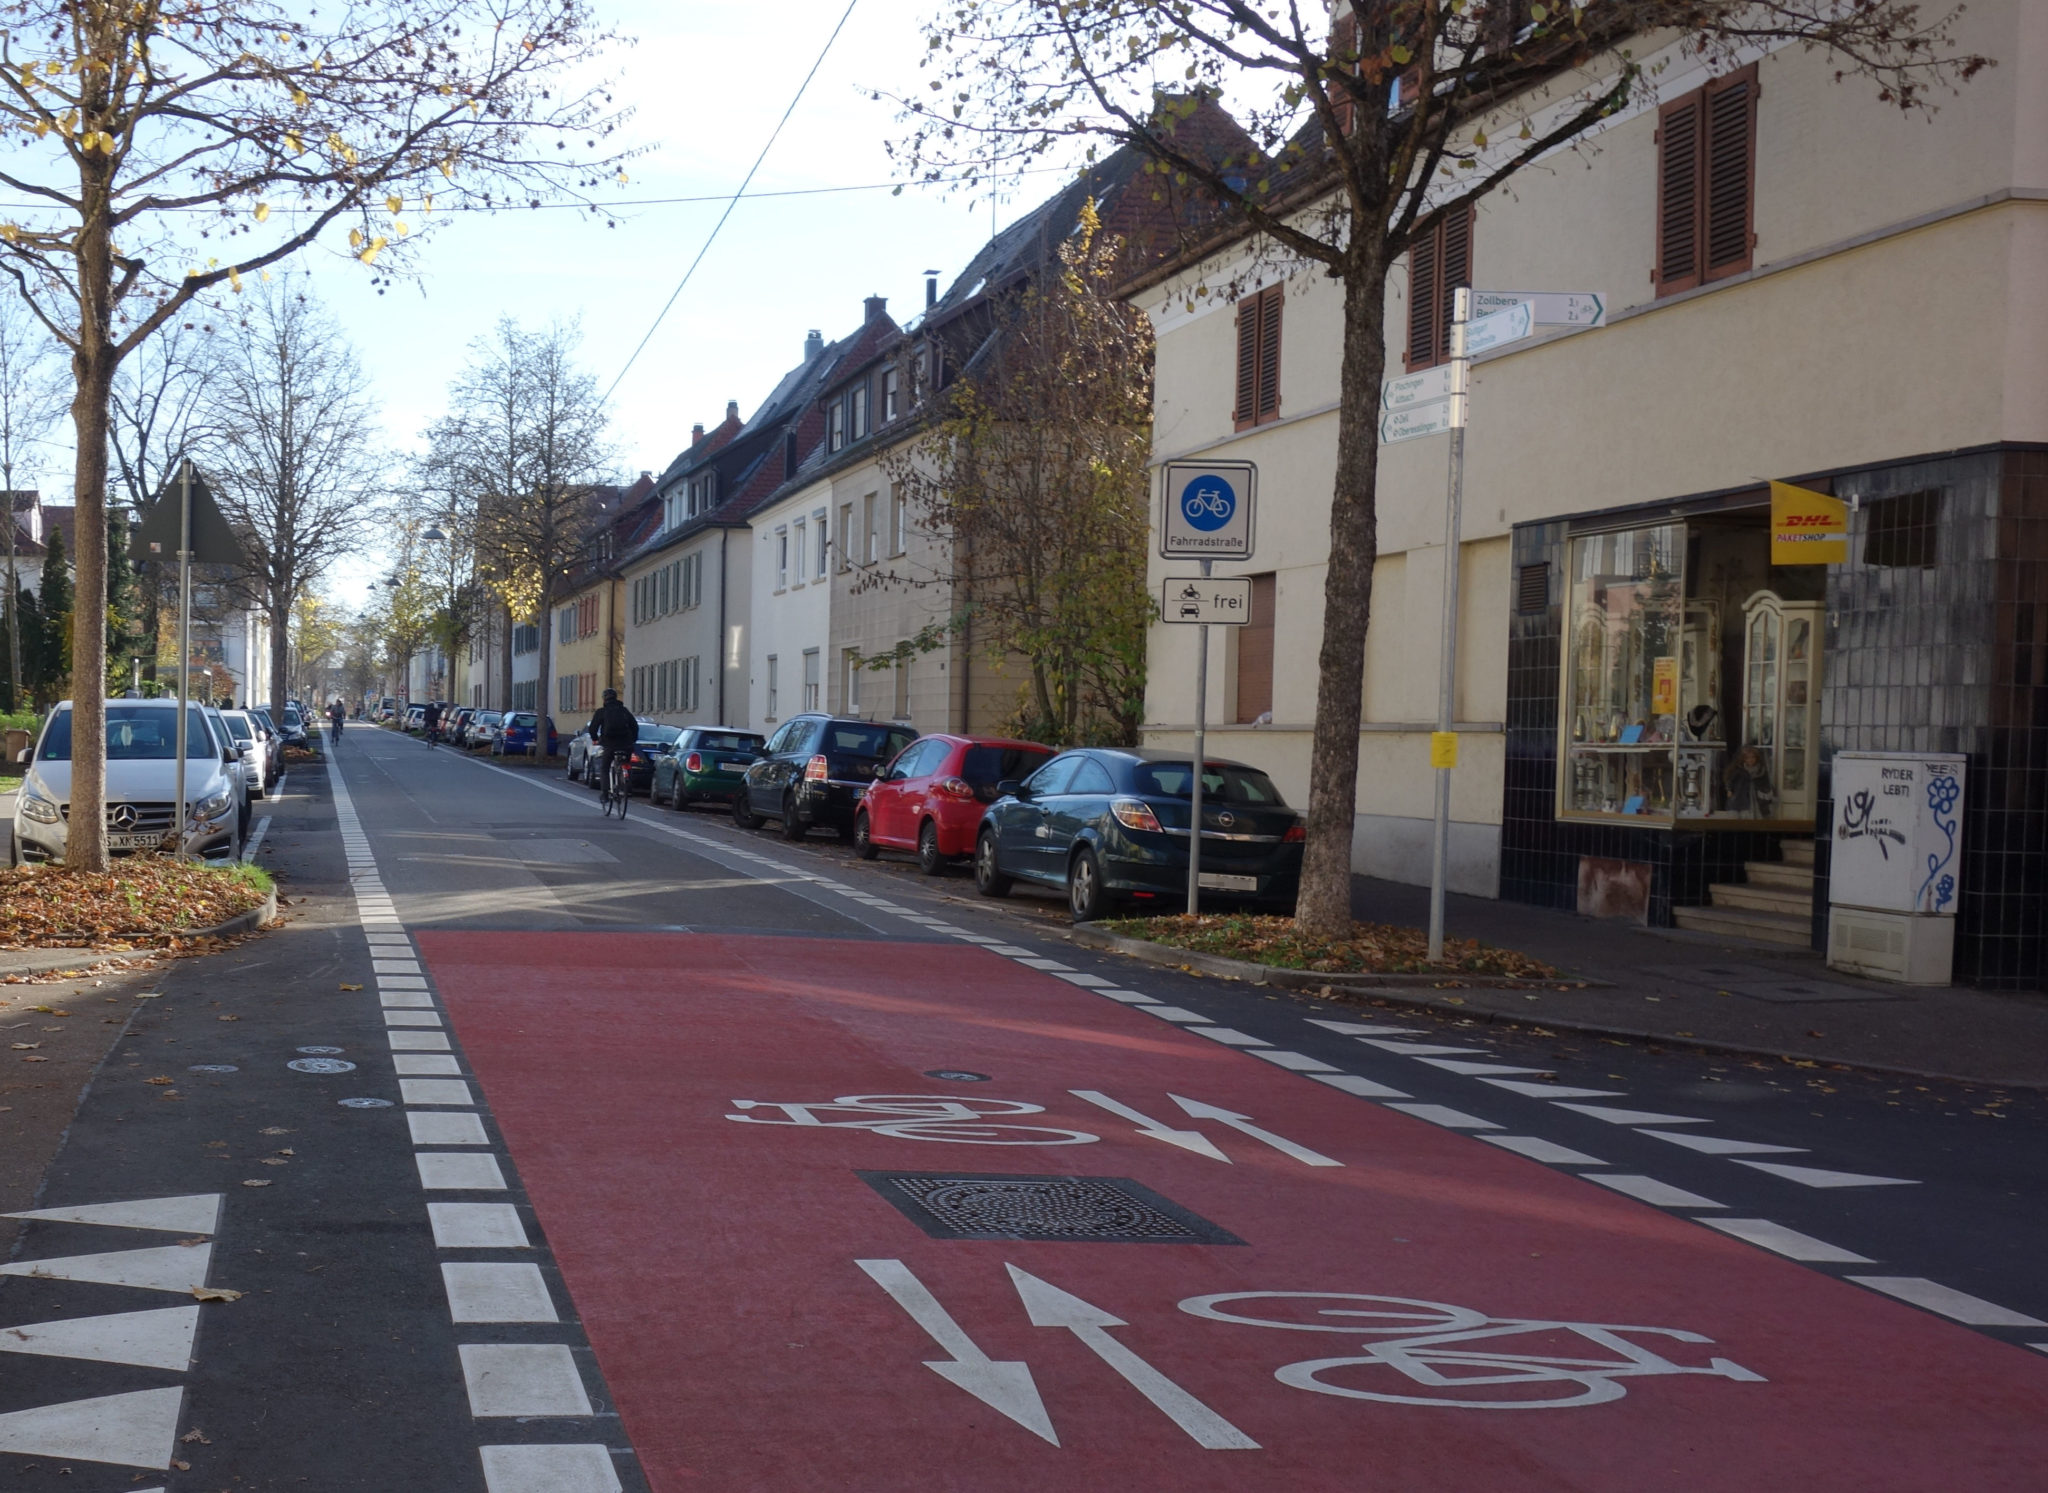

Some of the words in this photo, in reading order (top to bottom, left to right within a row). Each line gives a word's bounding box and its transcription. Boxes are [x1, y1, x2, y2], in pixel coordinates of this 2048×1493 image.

[1786, 515, 1832, 527] DHL
[1170, 535, 1243, 548] Fahrradstraße
[1776, 533, 1826, 543] PAKETSHOP
[1214, 594, 1243, 609] frei
[1881, 767, 1913, 781] RYDER
[134, 835, 158, 847] 5511
